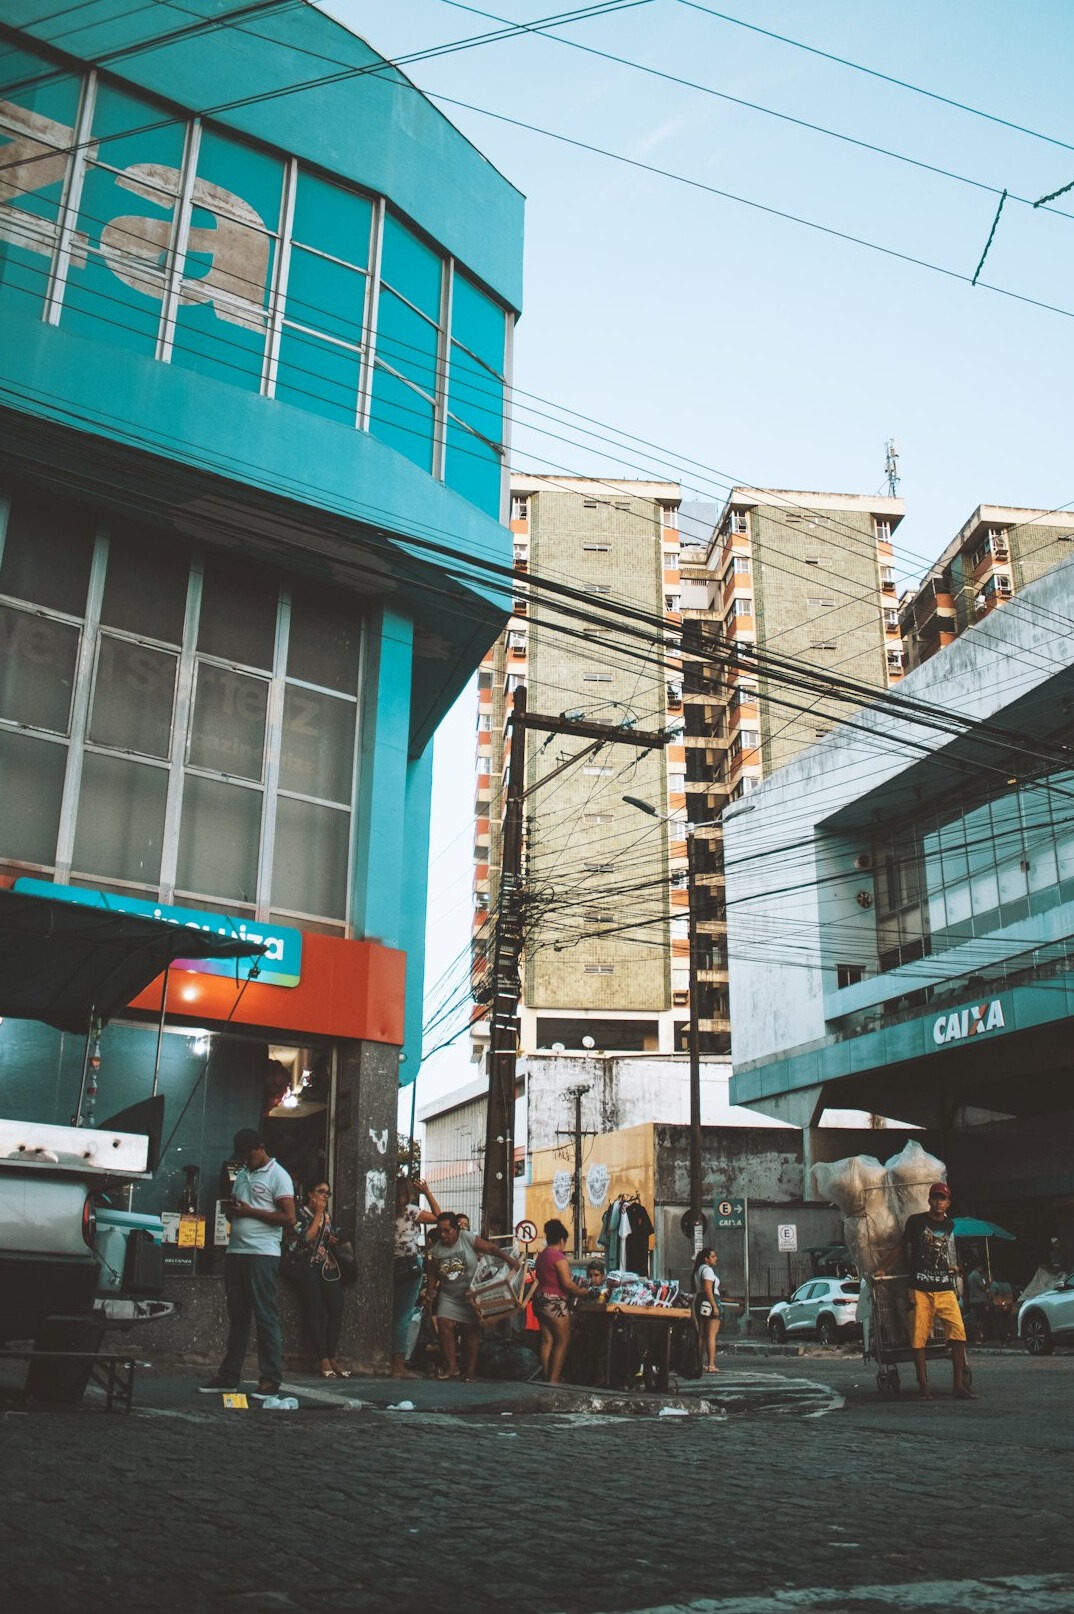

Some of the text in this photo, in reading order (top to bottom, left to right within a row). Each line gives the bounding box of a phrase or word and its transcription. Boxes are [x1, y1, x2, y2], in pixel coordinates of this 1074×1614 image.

[933, 999, 1005, 1045] CAIXA
[723, 1204, 728, 1213] E
[785, 1229, 790, 1237] E
